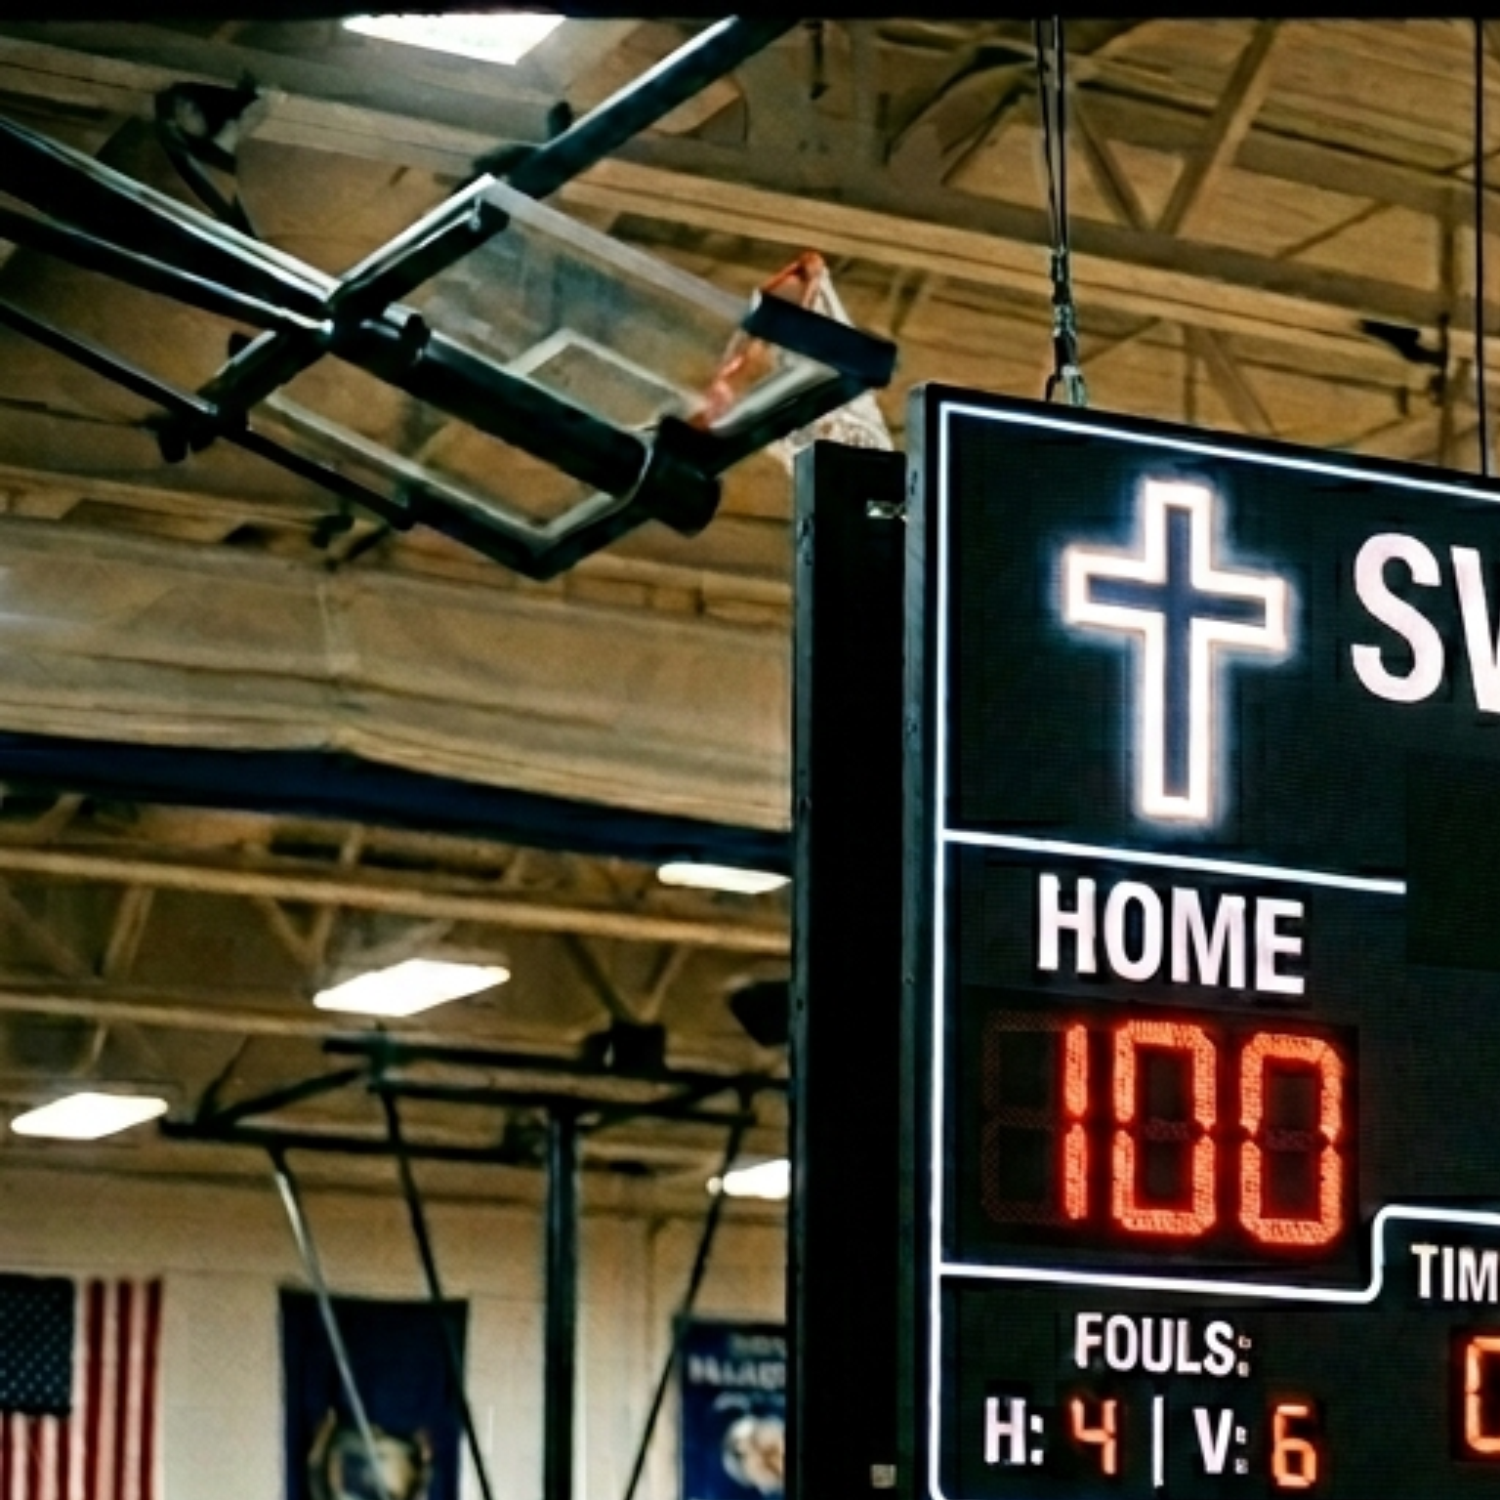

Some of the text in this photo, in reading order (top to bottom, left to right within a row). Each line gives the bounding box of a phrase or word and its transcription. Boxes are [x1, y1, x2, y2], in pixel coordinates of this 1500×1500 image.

[1038, 873, 1305, 995] HOME
[1062, 1019, 1343, 1246] 100
[1074, 1312, 1252, 1377] FOULS:
[984, 1396, 1318, 1488] H: 4 V: 6
